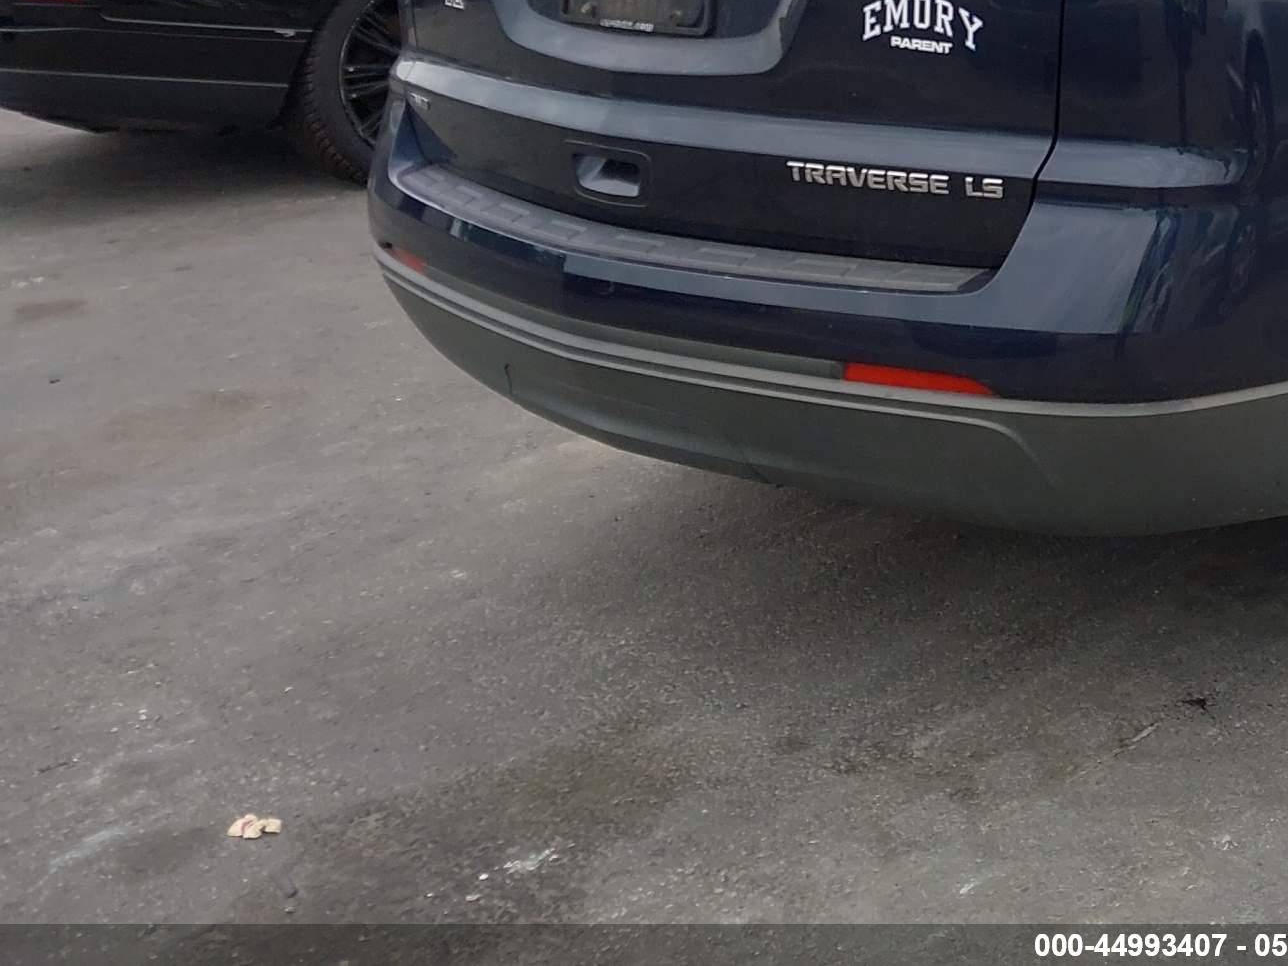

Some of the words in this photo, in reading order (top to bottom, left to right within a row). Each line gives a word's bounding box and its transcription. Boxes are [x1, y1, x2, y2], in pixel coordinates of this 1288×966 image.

[890, 35, 953, 54] PARENT
[786, 161, 950, 195] TRAVERSE
[966, 176, 1004, 199] LS
